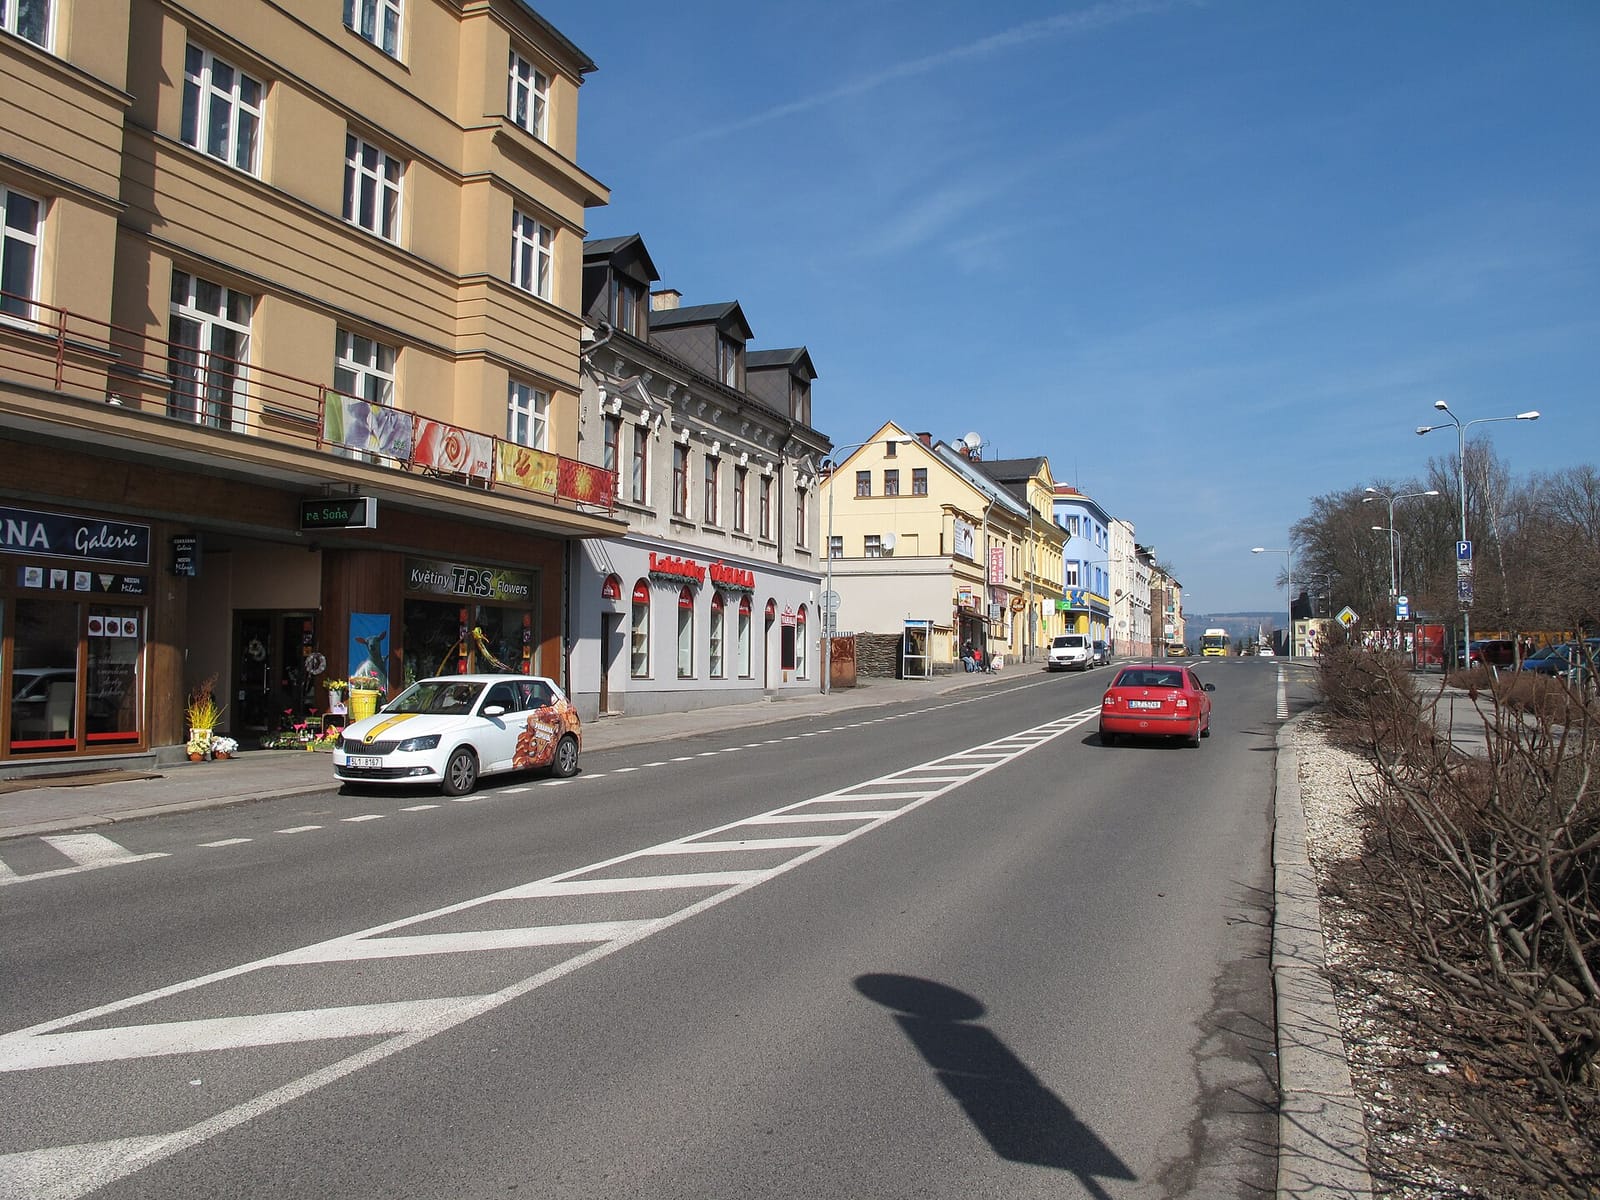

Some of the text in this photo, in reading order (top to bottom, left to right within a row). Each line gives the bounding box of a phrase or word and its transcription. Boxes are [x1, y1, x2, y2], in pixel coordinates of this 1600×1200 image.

[0, 518, 138, 556] NA Galerie
[1460, 543, 1468, 554] P
[411, 568, 450, 588] Květiny
[498, 580, 528, 595] Flowers
